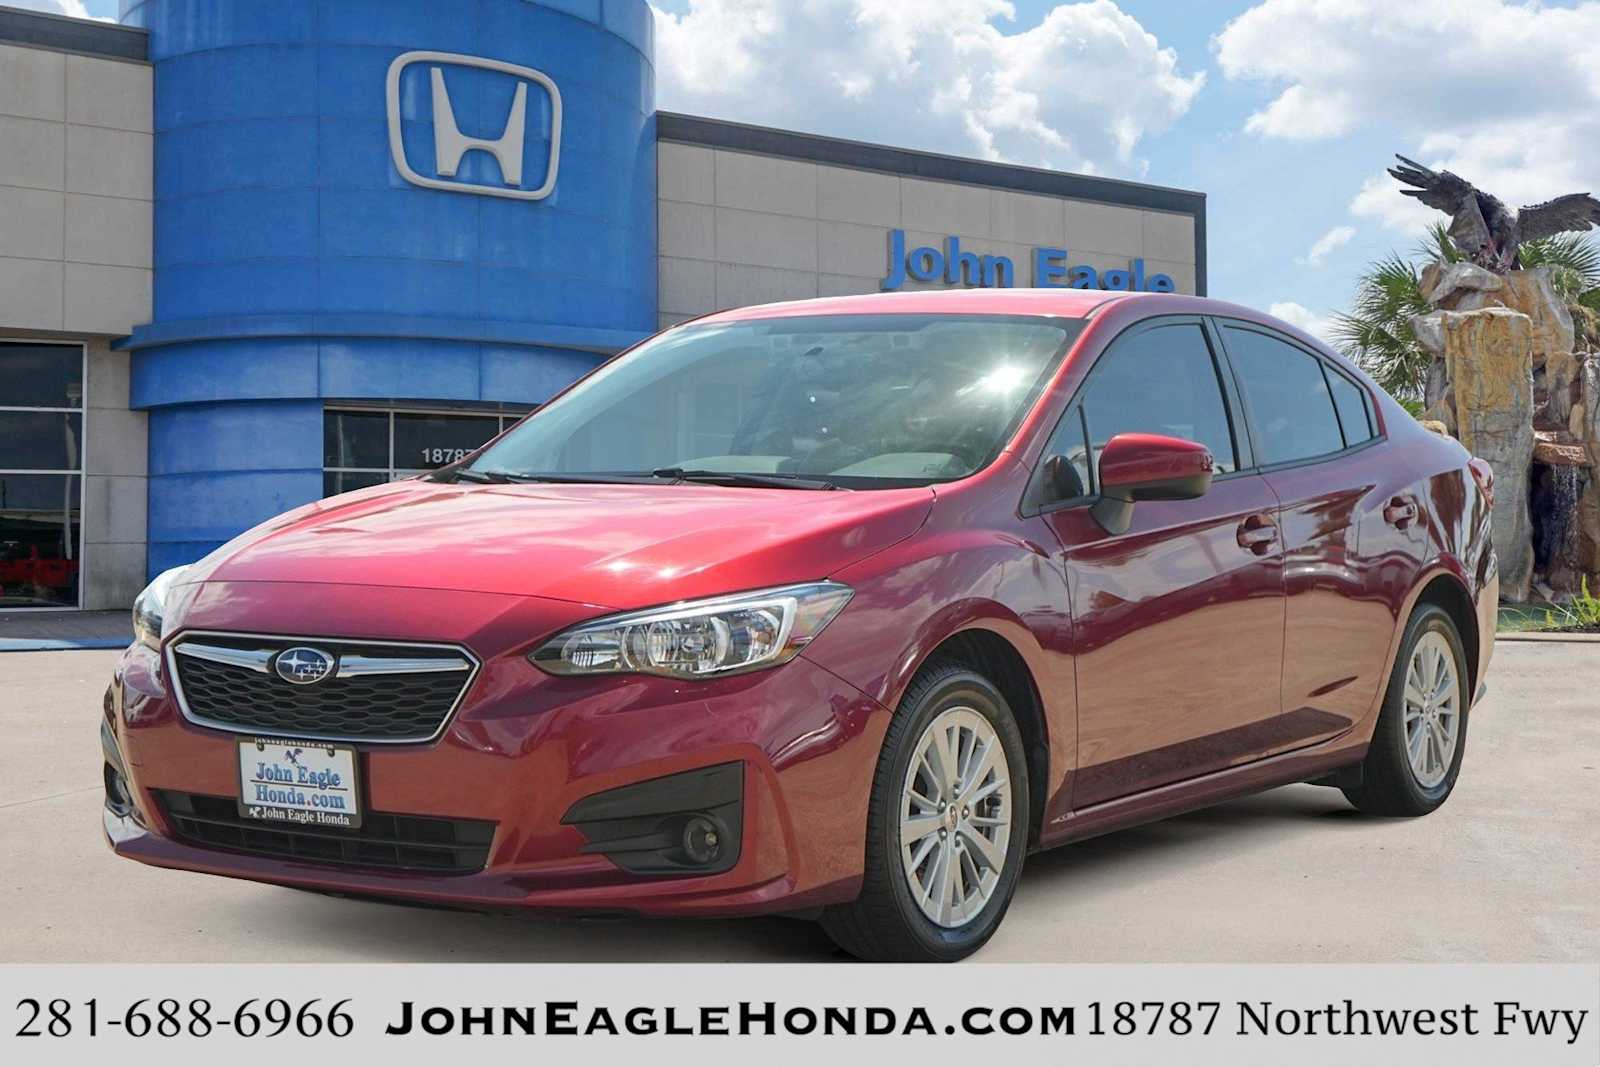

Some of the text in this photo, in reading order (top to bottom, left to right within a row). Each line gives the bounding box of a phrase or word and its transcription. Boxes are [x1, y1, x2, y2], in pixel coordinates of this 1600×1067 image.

[880, 229, 1176, 293] John Eagle
[255, 762, 341, 790] John Eagle
[255, 784, 346, 809] Honda.com
[261, 806, 350, 826] John Eagle Honda
